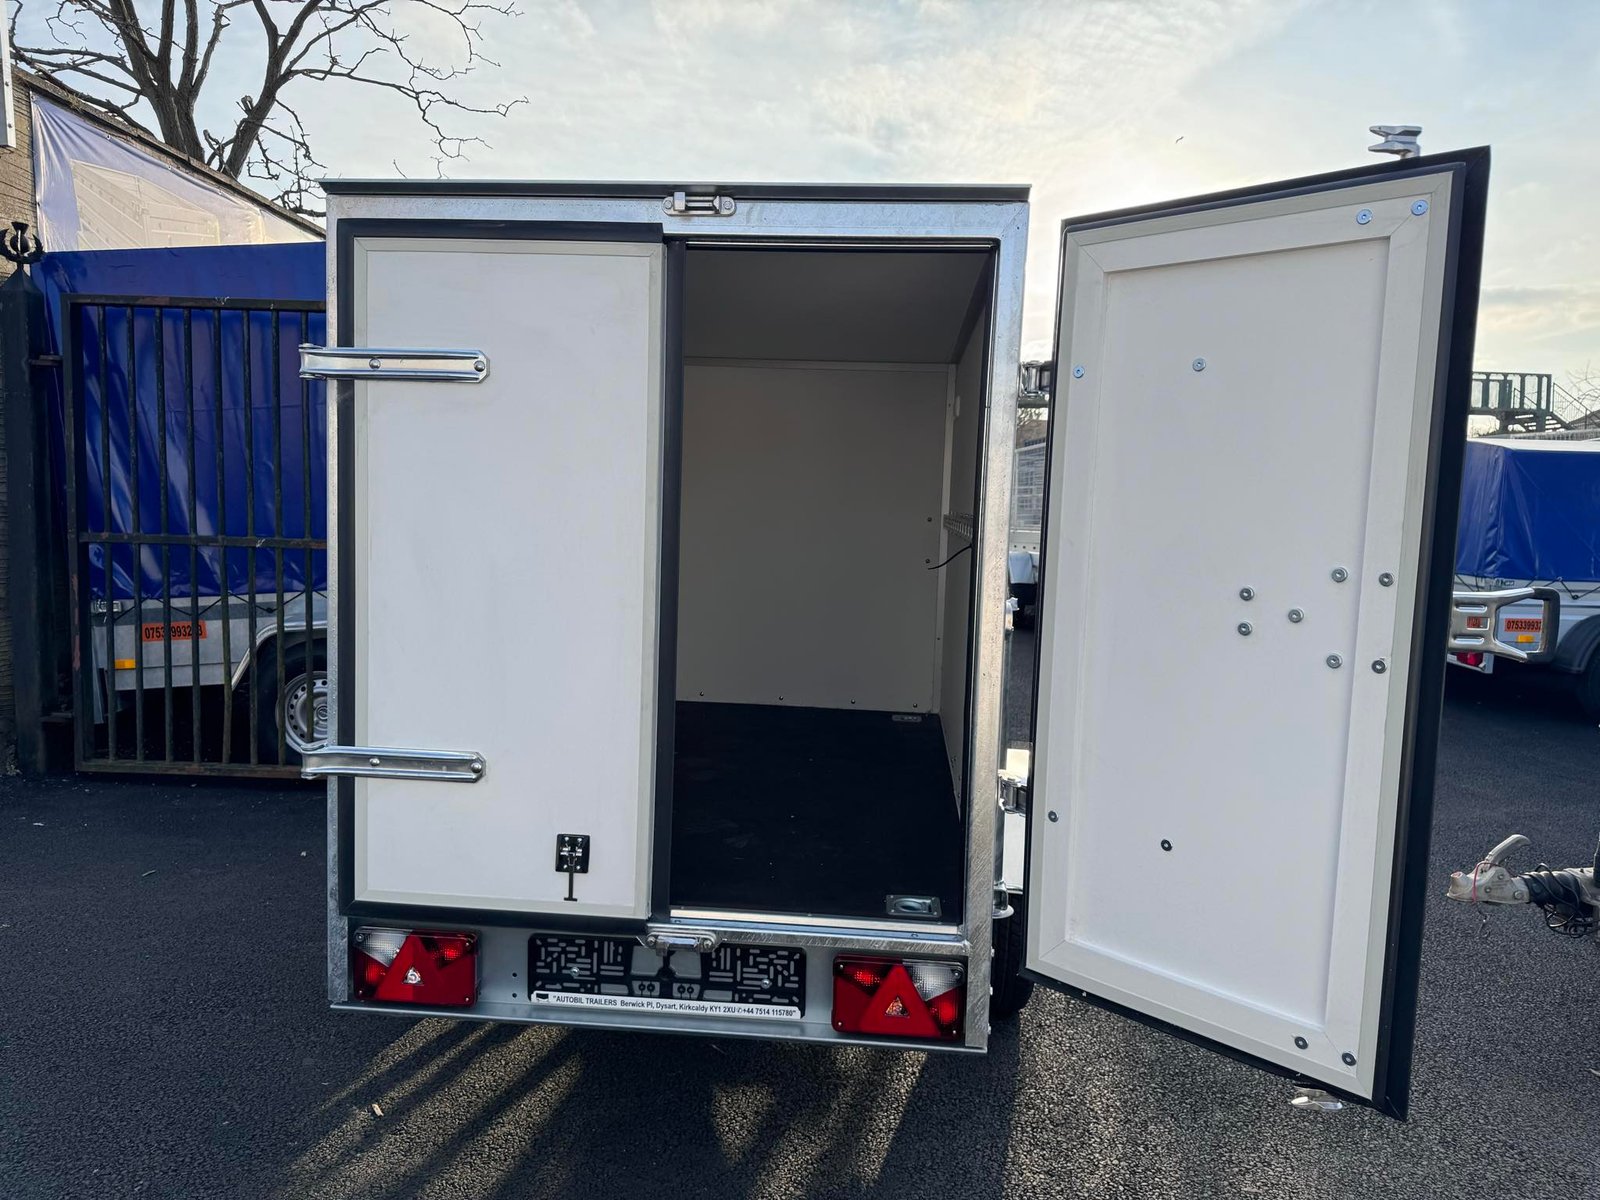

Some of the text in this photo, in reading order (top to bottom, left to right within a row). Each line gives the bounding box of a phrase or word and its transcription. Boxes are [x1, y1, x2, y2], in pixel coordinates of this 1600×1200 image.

[144, 624, 203, 639] 075399323
[586, 997, 617, 1006] TRAILERS
[620, 999, 645, 1008] Berwick
[679, 1003, 708, 1013] Kirkcaldy
[755, 1007, 770, 1015] 7514
